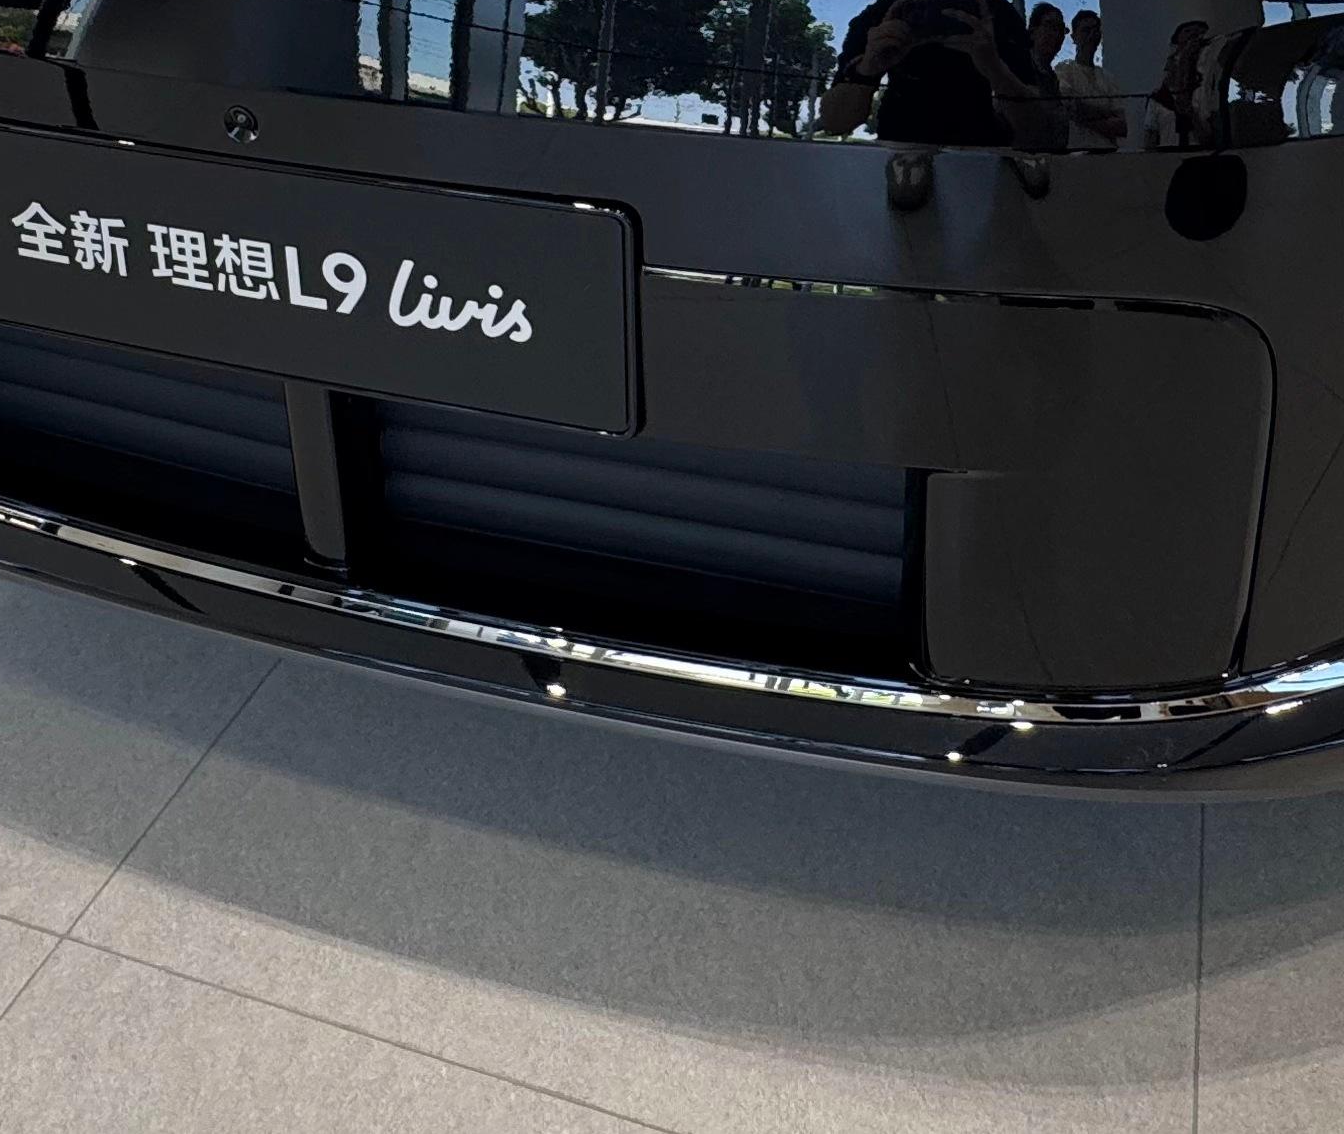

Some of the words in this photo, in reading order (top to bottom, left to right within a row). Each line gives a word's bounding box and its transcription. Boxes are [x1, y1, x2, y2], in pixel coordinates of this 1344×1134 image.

[11, 201, 130, 278] 全新
[147, 222, 368, 316] 理想L9
[388, 258, 534, 344] livis
